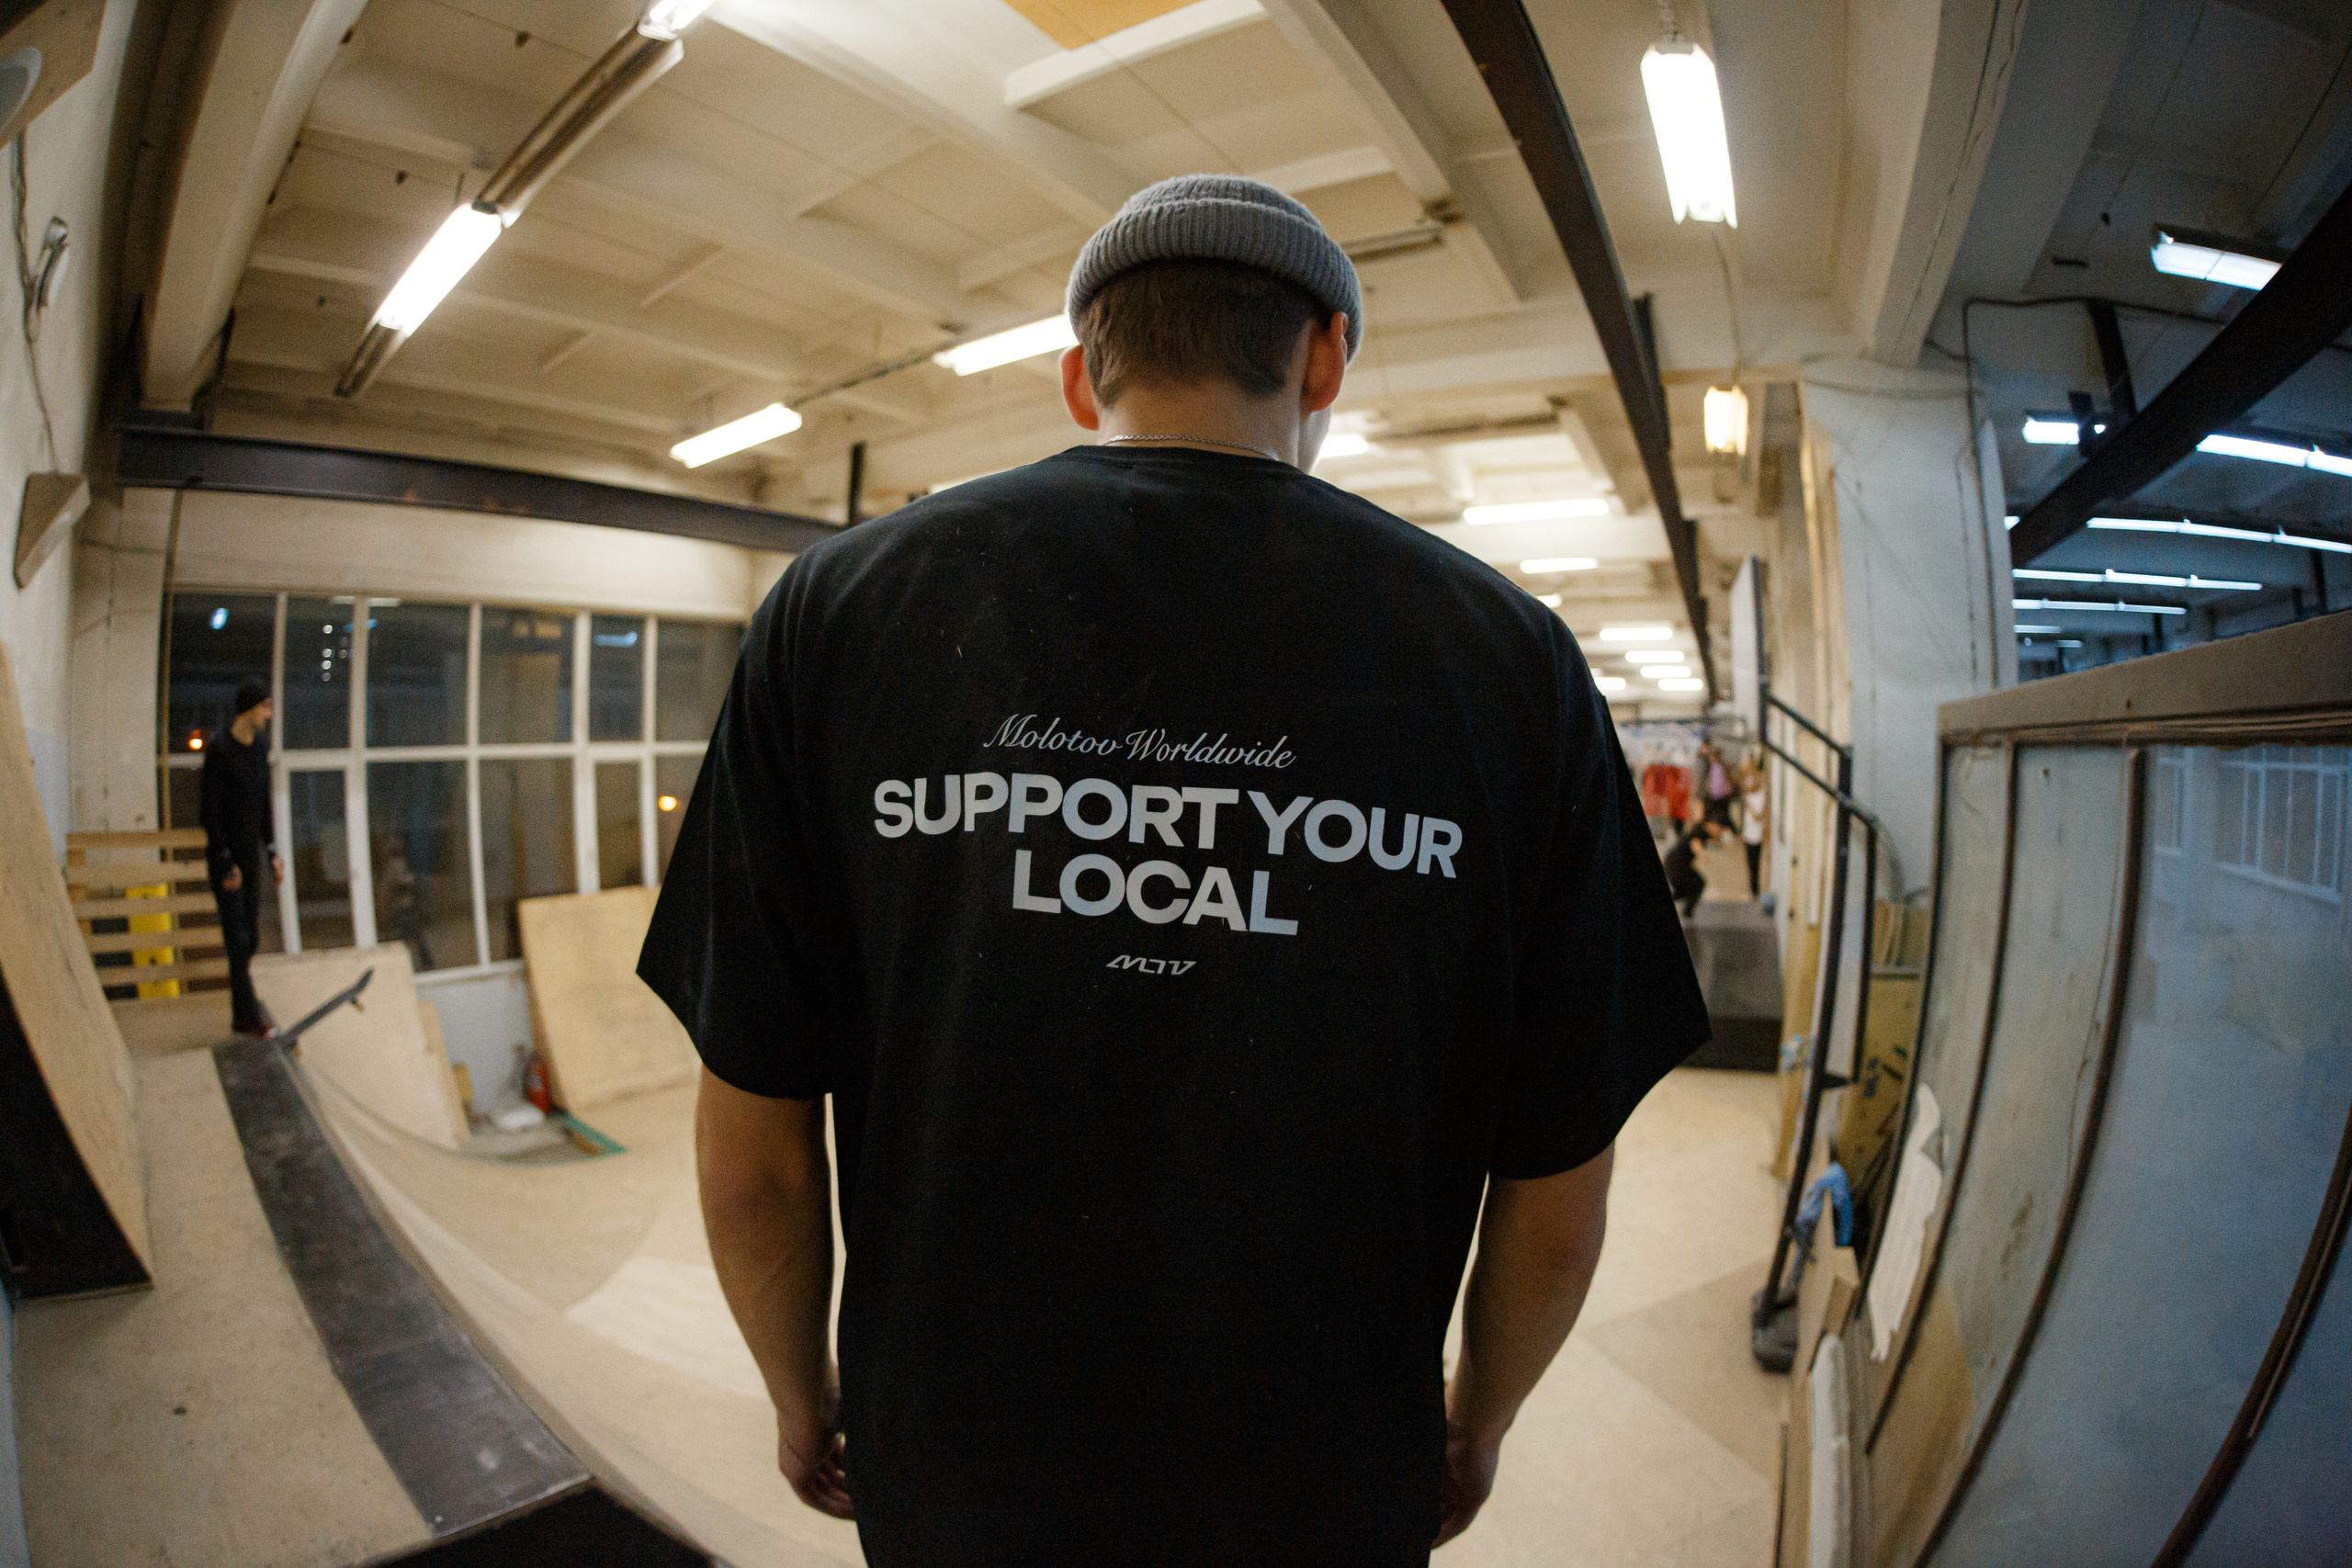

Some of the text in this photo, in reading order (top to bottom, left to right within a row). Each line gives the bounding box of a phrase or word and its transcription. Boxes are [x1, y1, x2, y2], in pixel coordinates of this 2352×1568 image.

[982, 713, 1296, 769] Molotov Worldwide
[874, 772, 1463, 879] SUPPORT YOUR
[1012, 850, 1299, 936] LOCAL
